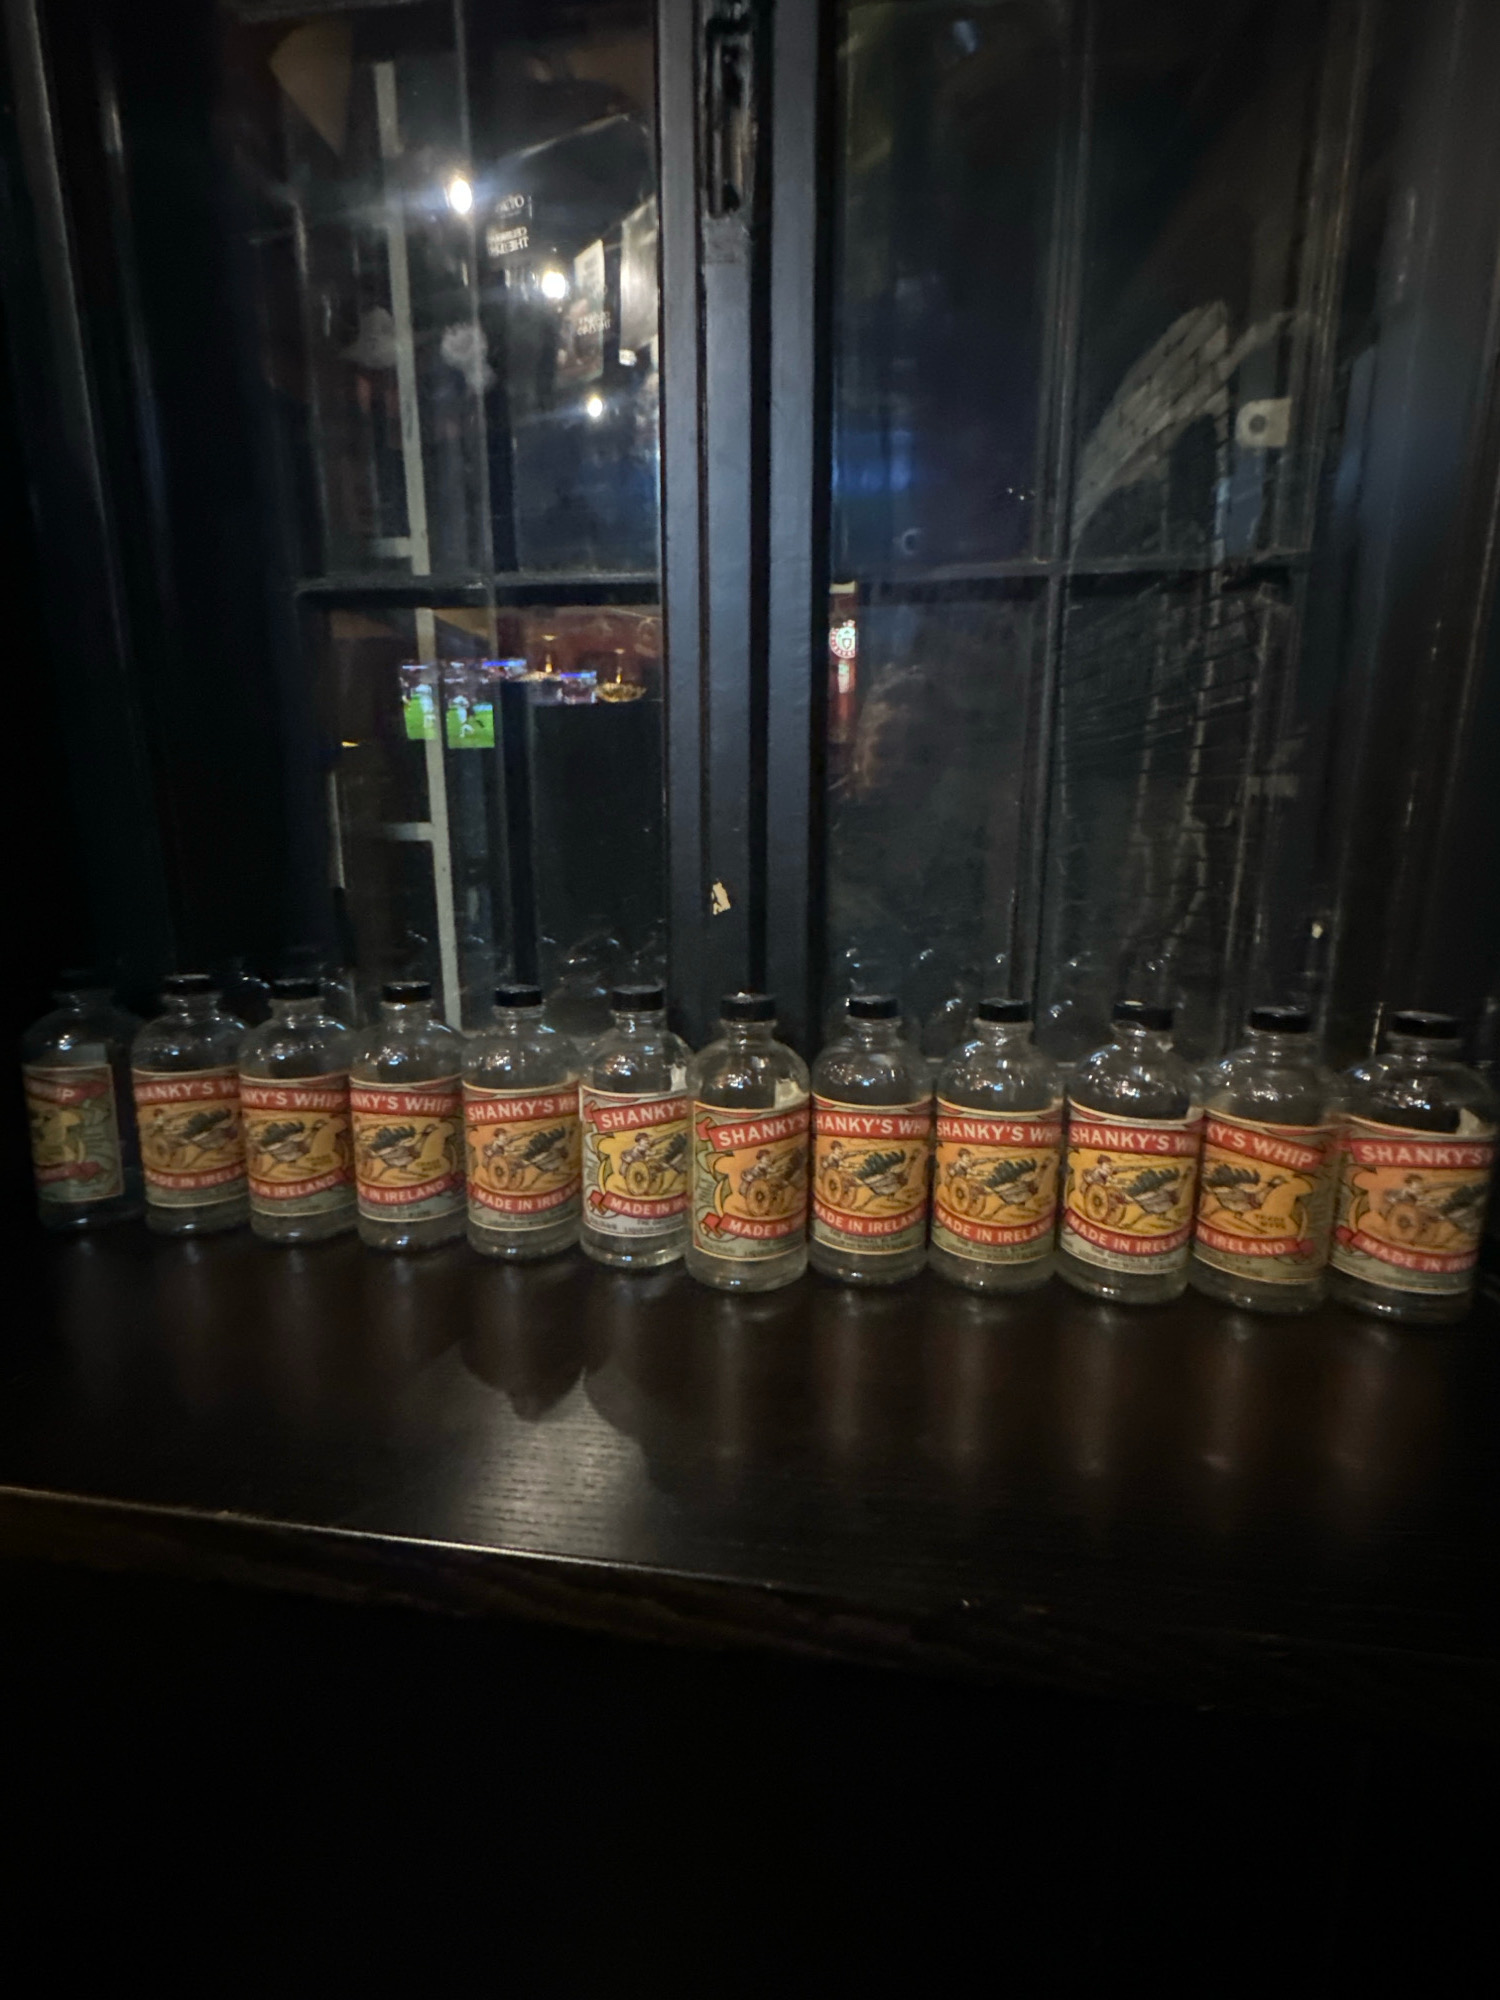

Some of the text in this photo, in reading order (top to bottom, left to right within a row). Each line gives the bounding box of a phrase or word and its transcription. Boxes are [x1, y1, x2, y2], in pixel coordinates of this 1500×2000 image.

[468, 1098, 555, 1121] SHANKY'S
[600, 1100, 688, 1129] SHANKY'S
[936, 1121, 1024, 1141] SHANKY'S
[1070, 1124, 1171, 1151] SHANKY'S
[1253, 1136, 1313, 1167] WHIP
[517, 1199, 533, 1211] IN
[610, 1197, 651, 1216] MADE
[728, 1219, 773, 1237] MADE
[848, 1219, 863, 1233] IN
[975, 1228, 993, 1242] IN
[1069, 1215, 1109, 1246] MADE
[1113, 1237, 1131, 1253] IN
